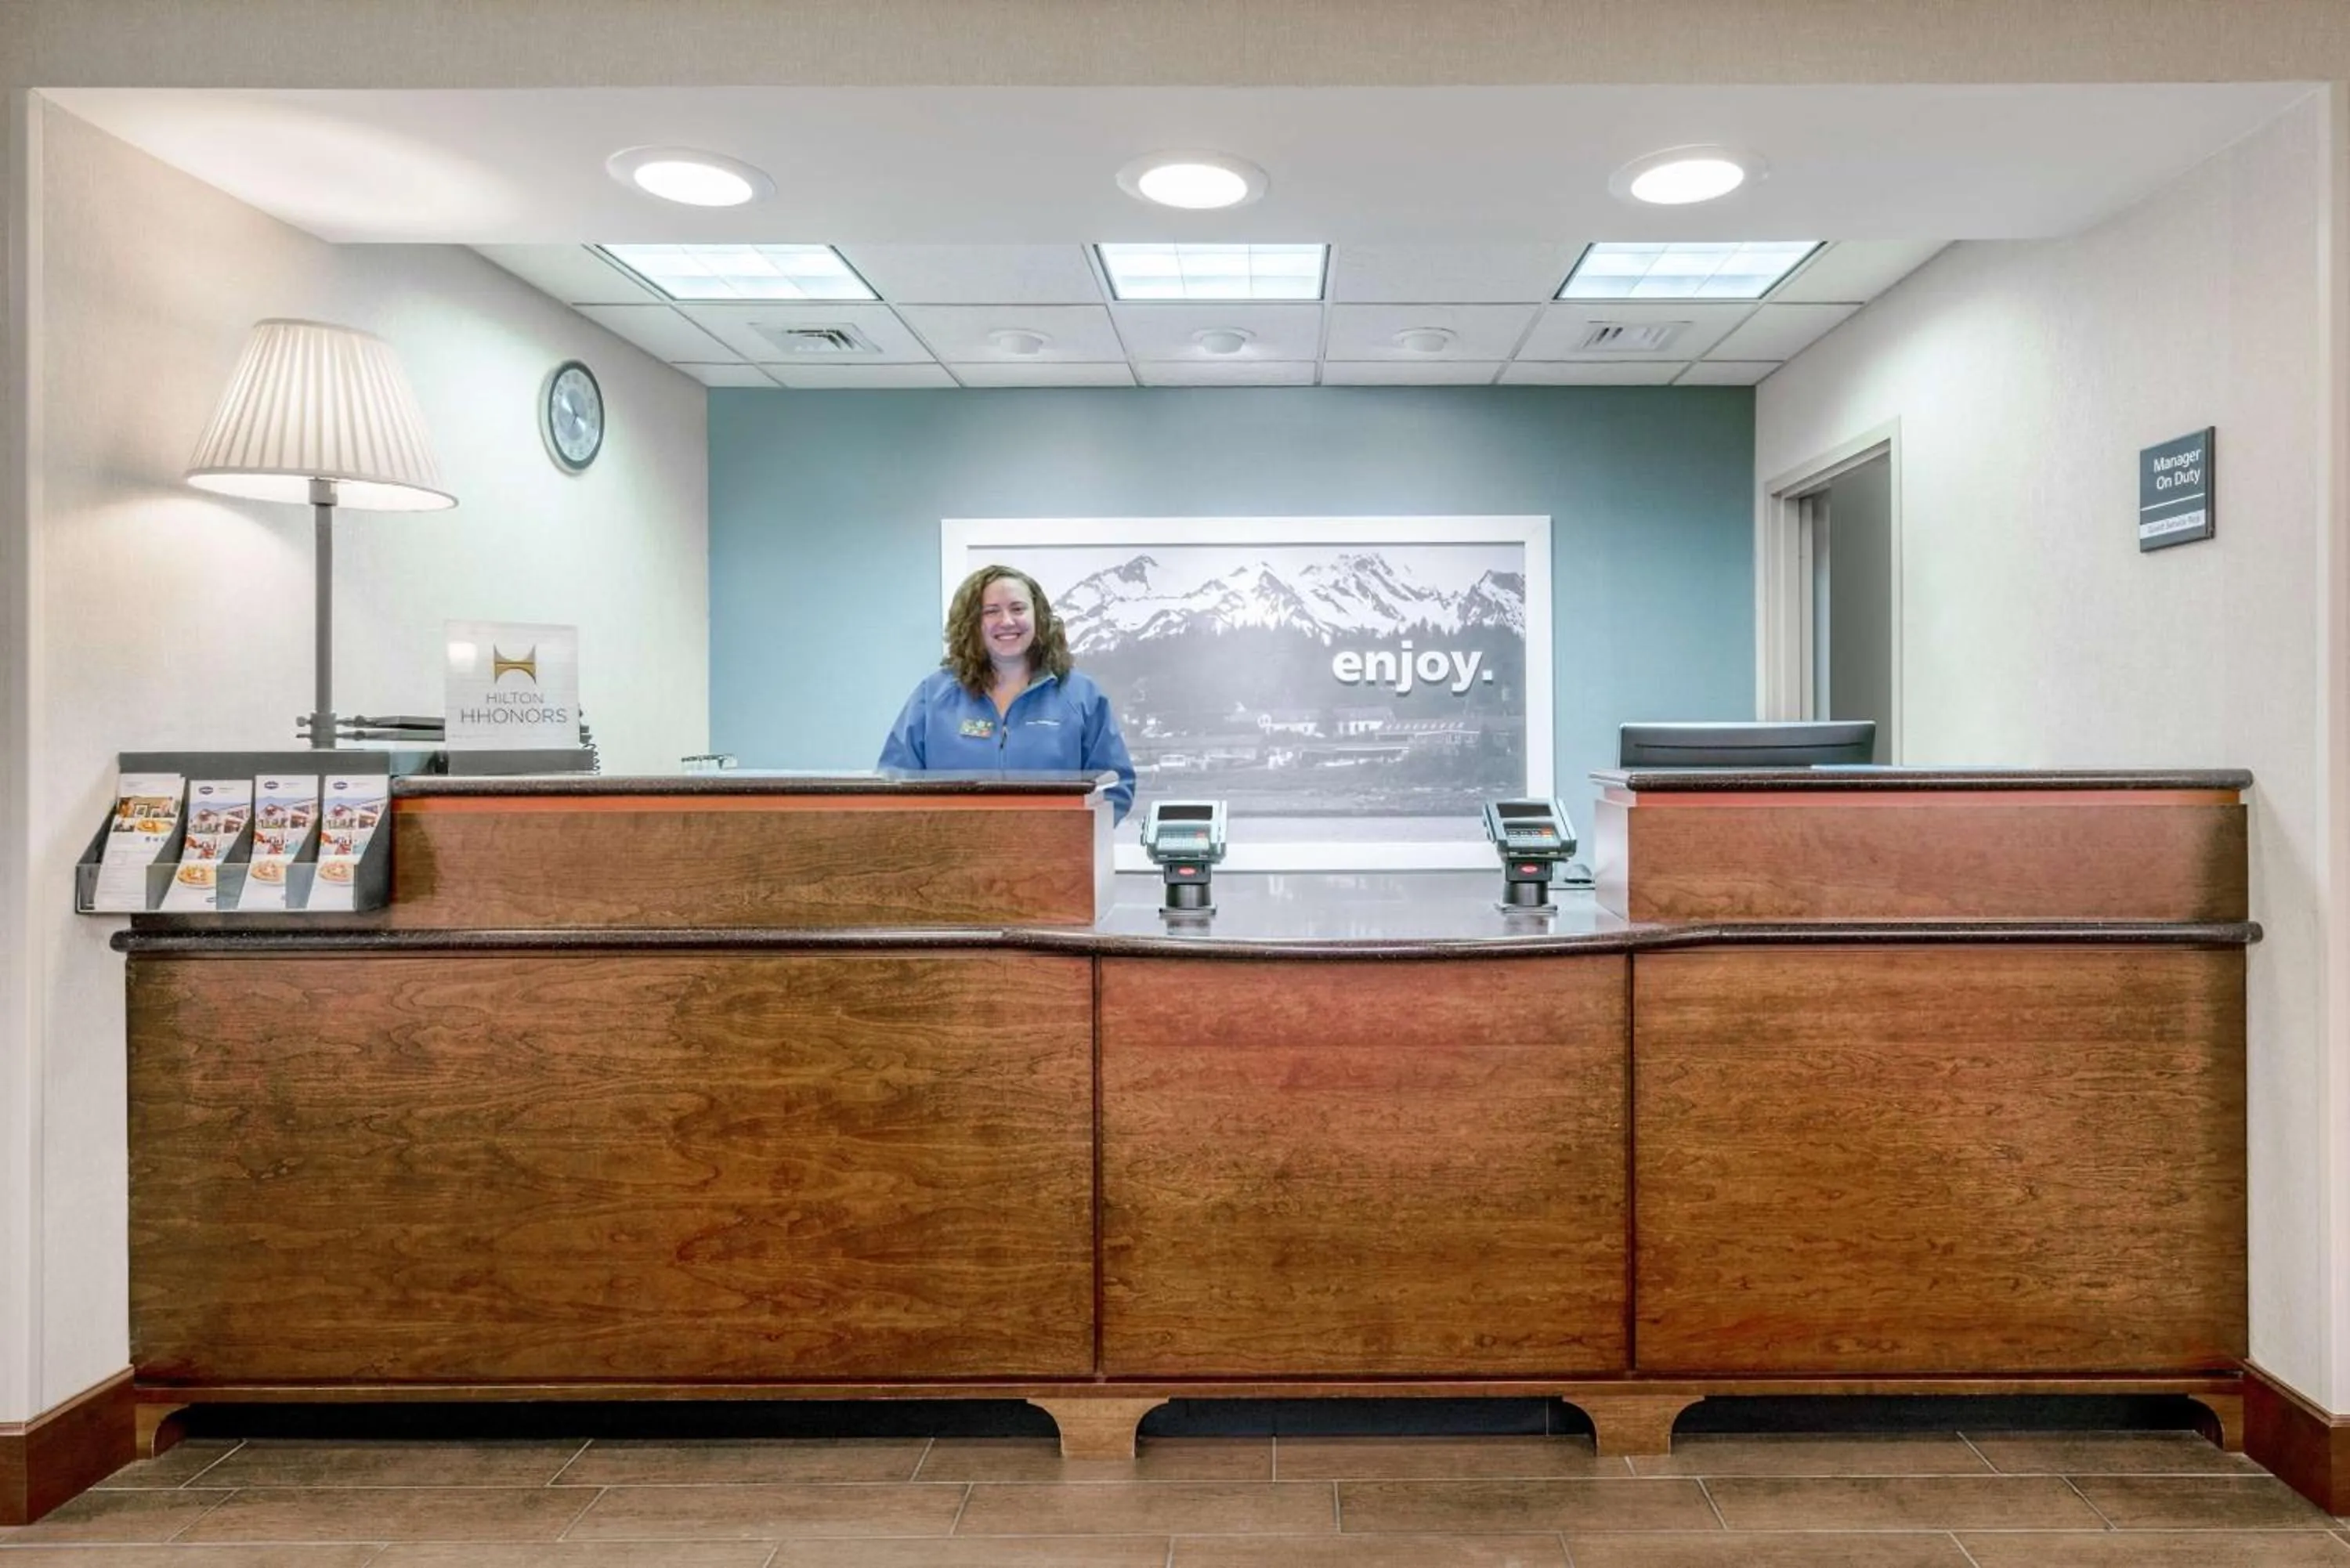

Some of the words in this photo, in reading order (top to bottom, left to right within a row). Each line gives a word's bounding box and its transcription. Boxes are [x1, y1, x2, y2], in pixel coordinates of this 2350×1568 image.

[2153, 449, 2202, 472] Manager
[2157, 475, 2172, 490] On
[2175, 469, 2200, 486] Duty
[1332, 640, 1493, 693] enjoy.
[486, 692, 544, 704] HILTON
[461, 707, 568, 724] HHONORS
